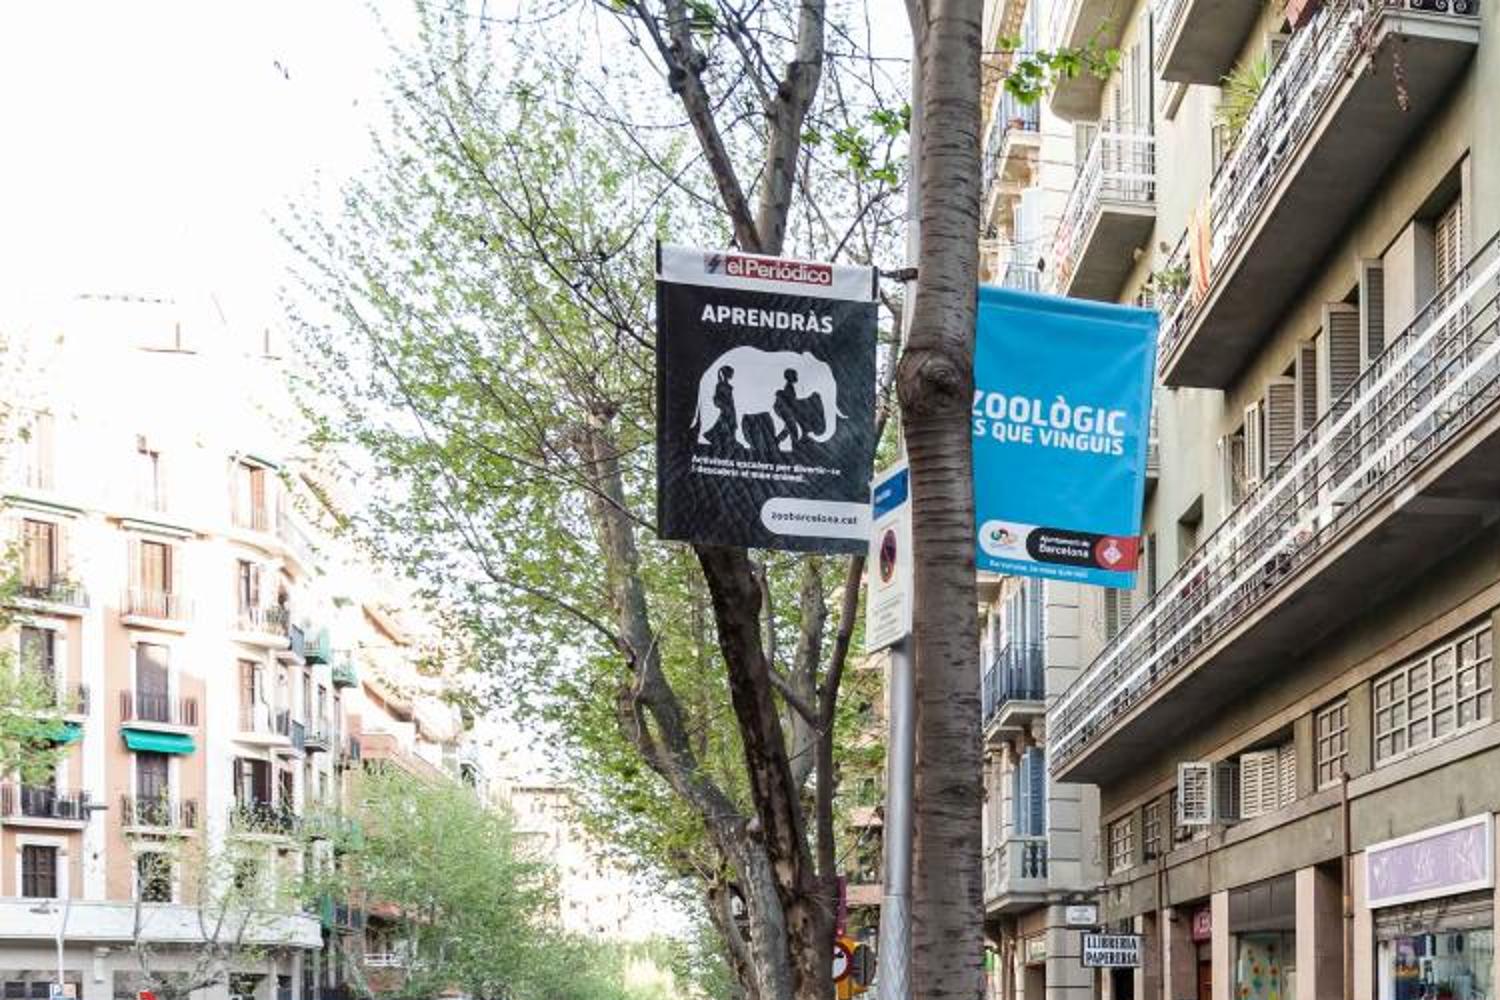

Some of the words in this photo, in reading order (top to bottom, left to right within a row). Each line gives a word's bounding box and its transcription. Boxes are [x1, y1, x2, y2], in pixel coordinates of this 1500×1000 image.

[727, 260, 743, 275] el
[746, 259, 830, 284] Periódico
[701, 304, 833, 334] APRENDRÀS
[992, 421, 1033, 444] QUE
[1040, 427, 1125, 455] VINGUIS
[1039, 544, 1089, 558] Barcelona
[1087, 937, 1136, 950] LLIBRERIA
